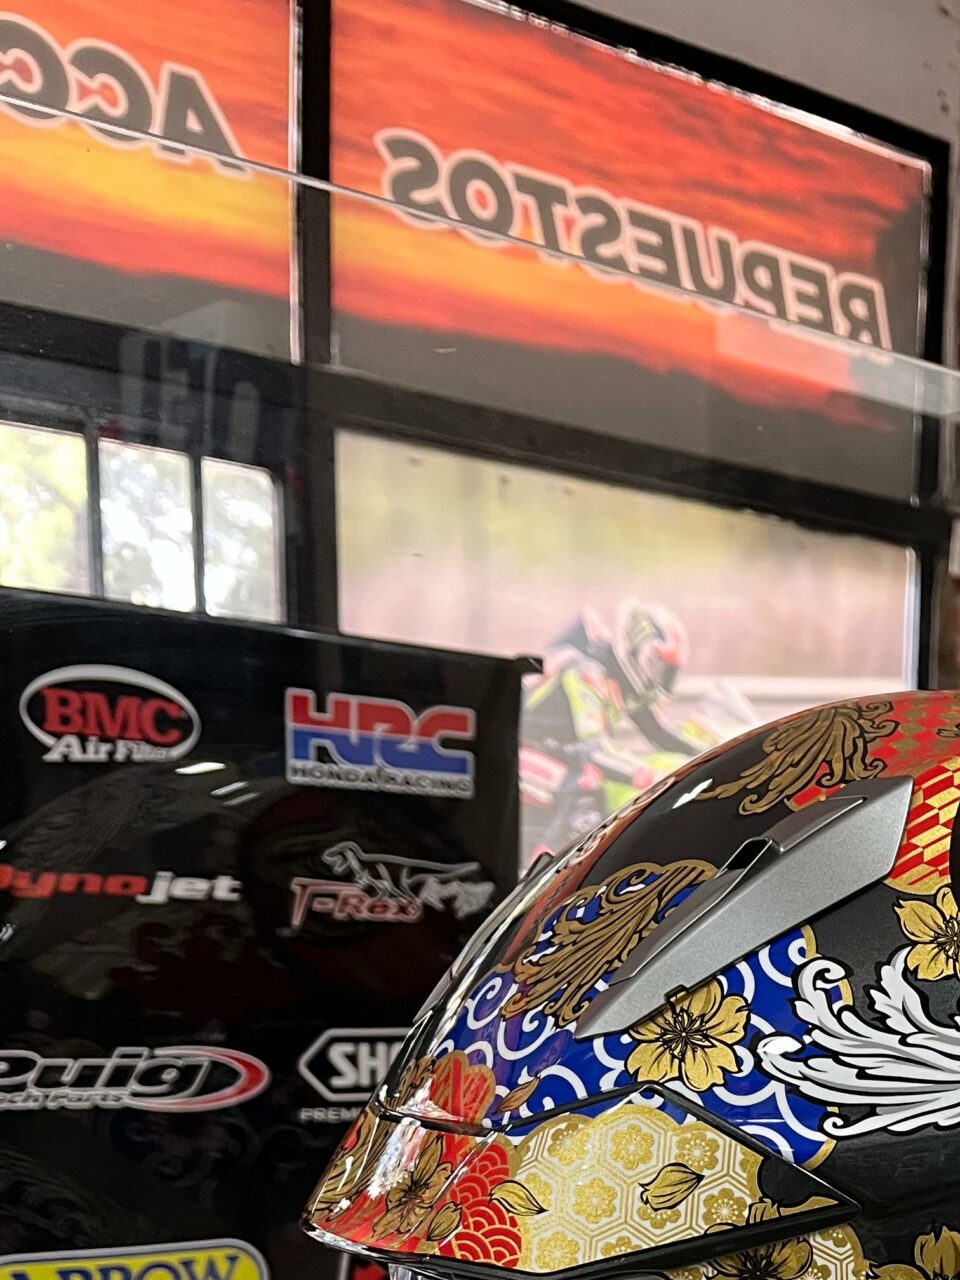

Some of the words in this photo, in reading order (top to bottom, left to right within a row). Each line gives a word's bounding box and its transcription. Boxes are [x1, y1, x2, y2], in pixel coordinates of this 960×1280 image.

[41, 686, 183, 748] BMC
[42, 734, 112, 762] Air
[286, 688, 476, 776] HRC
